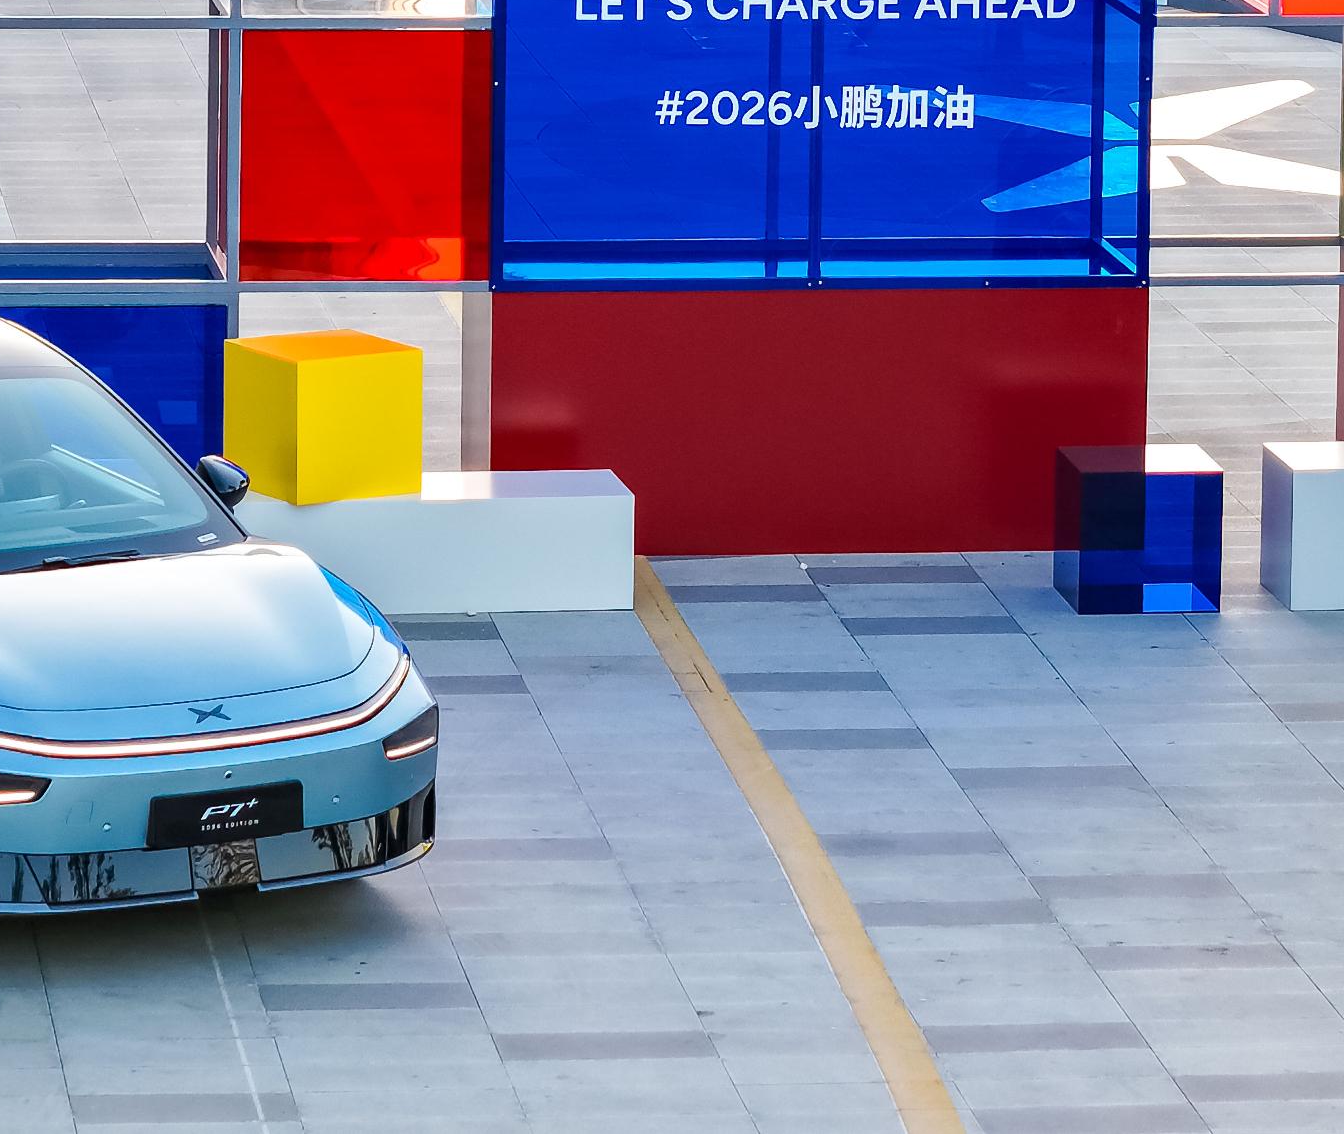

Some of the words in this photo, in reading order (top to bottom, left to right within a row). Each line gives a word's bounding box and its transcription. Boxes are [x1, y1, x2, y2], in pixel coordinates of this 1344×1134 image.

[655, 84, 975, 130] #2026小鹏加油
[200, 797, 259, 821] P7+
